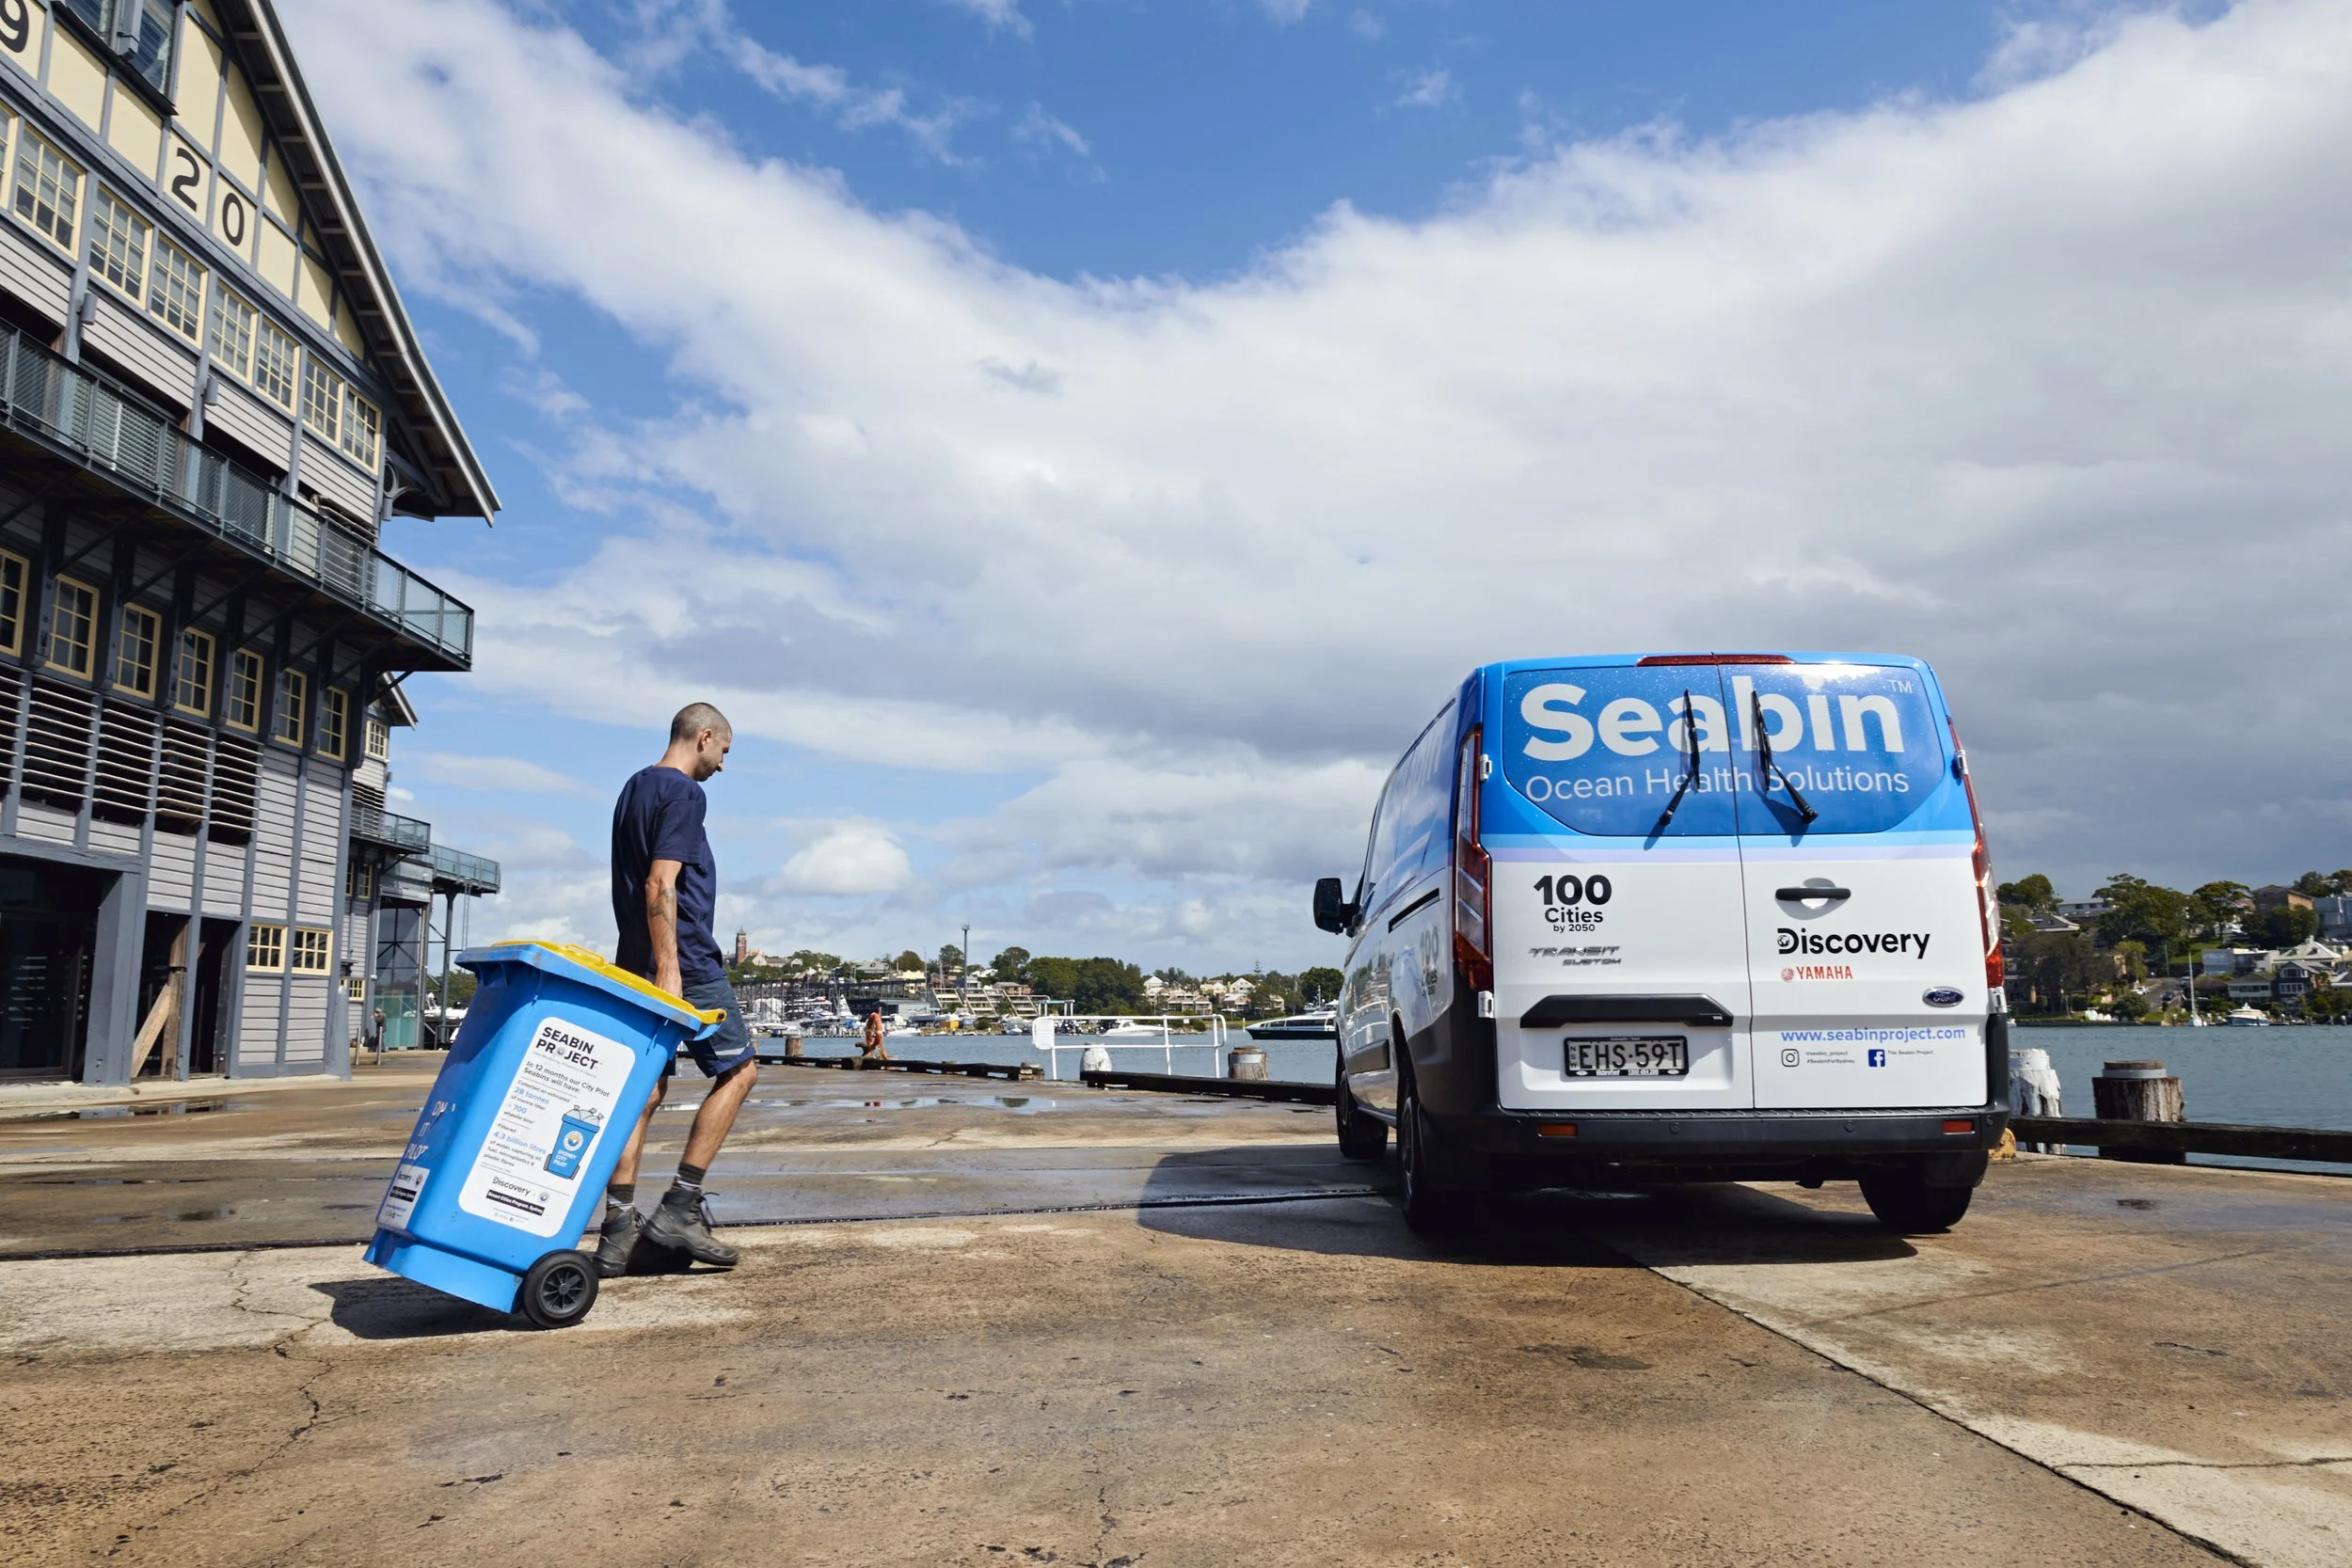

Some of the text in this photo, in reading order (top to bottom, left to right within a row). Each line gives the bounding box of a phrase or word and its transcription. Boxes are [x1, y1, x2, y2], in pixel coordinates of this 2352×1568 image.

[1888, 679, 1913, 693] TM
[1520, 675, 1904, 761] Seabin
[1526, 775, 1633, 801] Ocean
[1769, 765, 1909, 793] Solutions
[1534, 875, 1612, 905] 100
[1545, 907, 1603, 923] Cities
[1553, 924, 1596, 933] by 2050
[1777, 927, 1931, 959] Discovery
[1528, 946, 1620, 958] TRANSIT
[1563, 958, 1621, 966] CUSTOM
[1796, 966, 1853, 980] YAMAHA
[542, 1027, 595, 1053] SEABIN
[1781, 1027, 1965, 1043] www.seabinproject.com
[524, 1068, 549, 1082] Seabins
[550, 1078, 563, 1086] will
[544, 1068, 568, 1081] months
[581, 1082, 595, 1092] City
[596, 1087, 610, 1098] Pilot
[525, 1091, 549, 1104] tonnes
[506, 1135, 529, 1148] billion
[492, 1176, 532, 1196] Discovery
